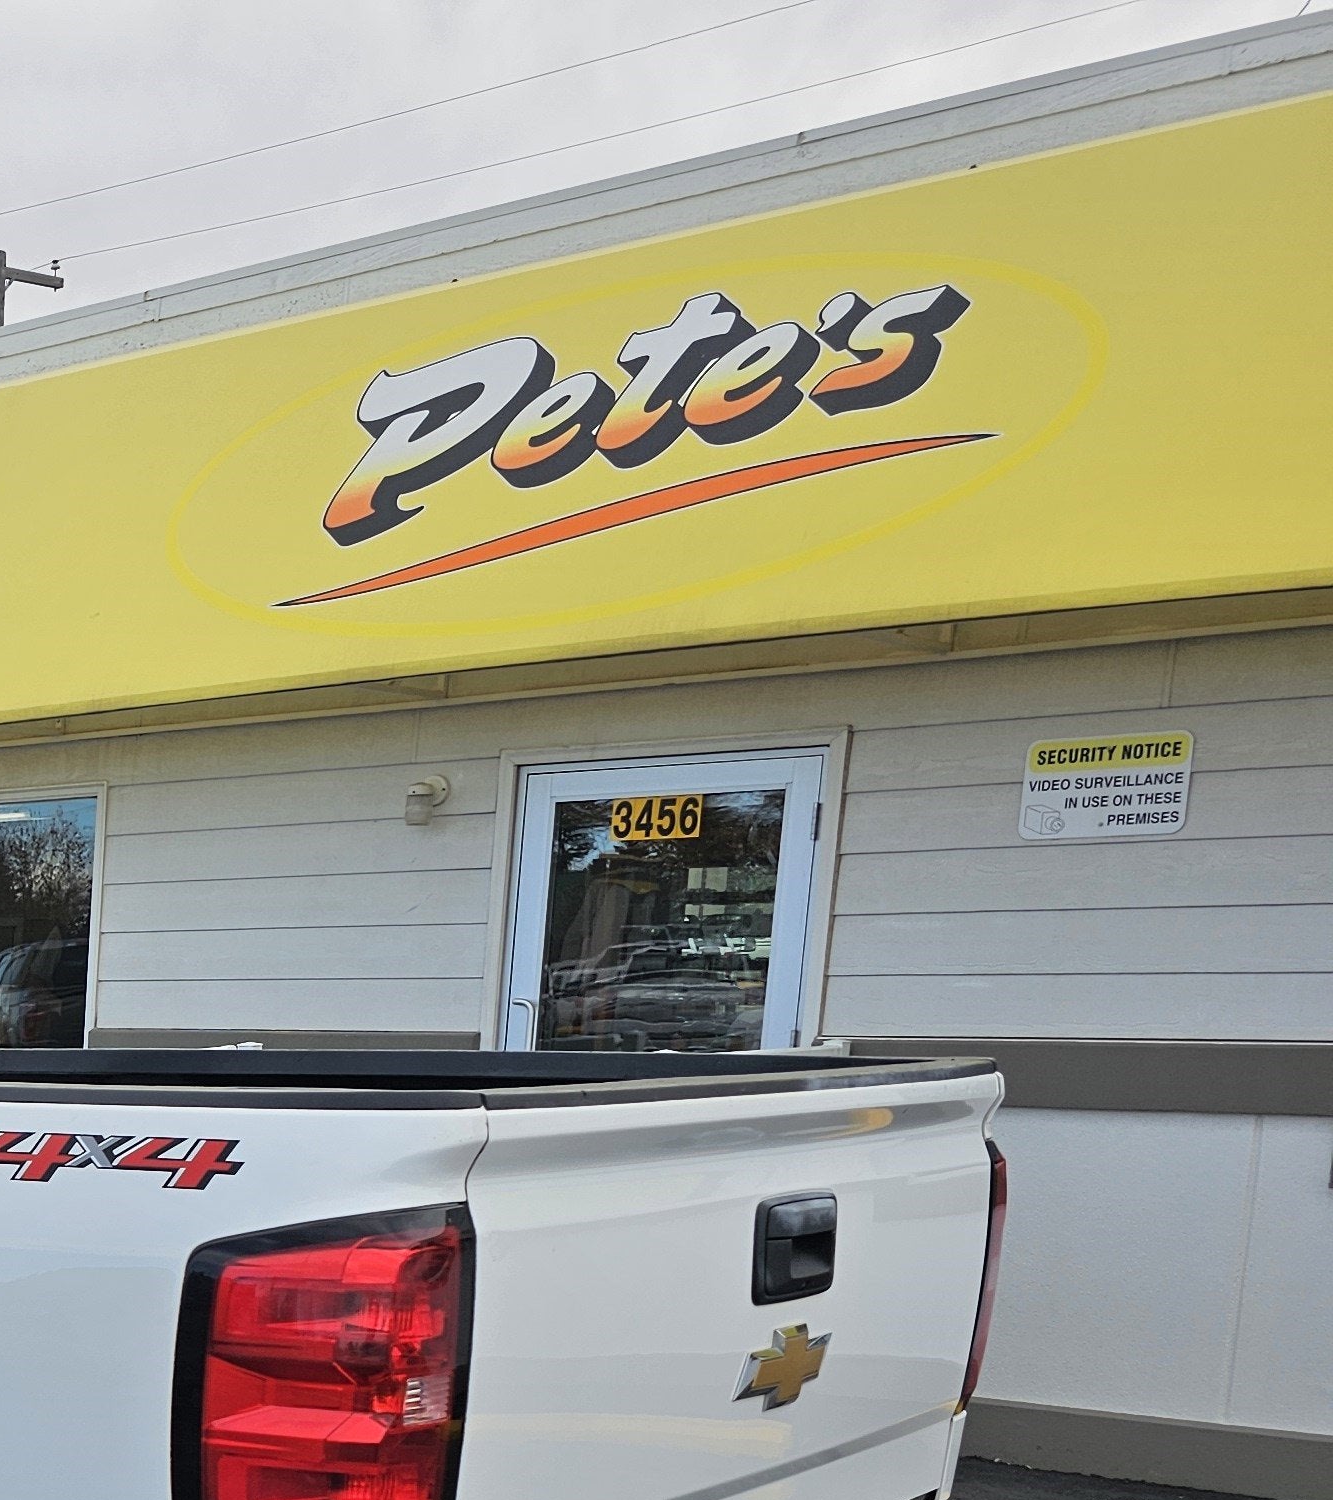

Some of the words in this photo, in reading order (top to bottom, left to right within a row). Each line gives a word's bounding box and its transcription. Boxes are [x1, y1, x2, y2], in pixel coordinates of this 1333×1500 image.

[322, 284, 972, 547] Pete's
[1037, 745, 1117, 766] SECURITY
[1121, 741, 1182, 760] NOTICE
[1029, 778, 1071, 792] VIDEO
[1074, 772, 1185, 789] SURVEILLANCE
[1064, 797, 1078, 809] IN
[1082, 796, 1108, 808] USE
[1112, 794, 1133, 806] ON
[1136, 791, 1182, 805] THESE
[613, 797, 700, 838] 3456
[1107, 811, 1179, 826] PREMISES
